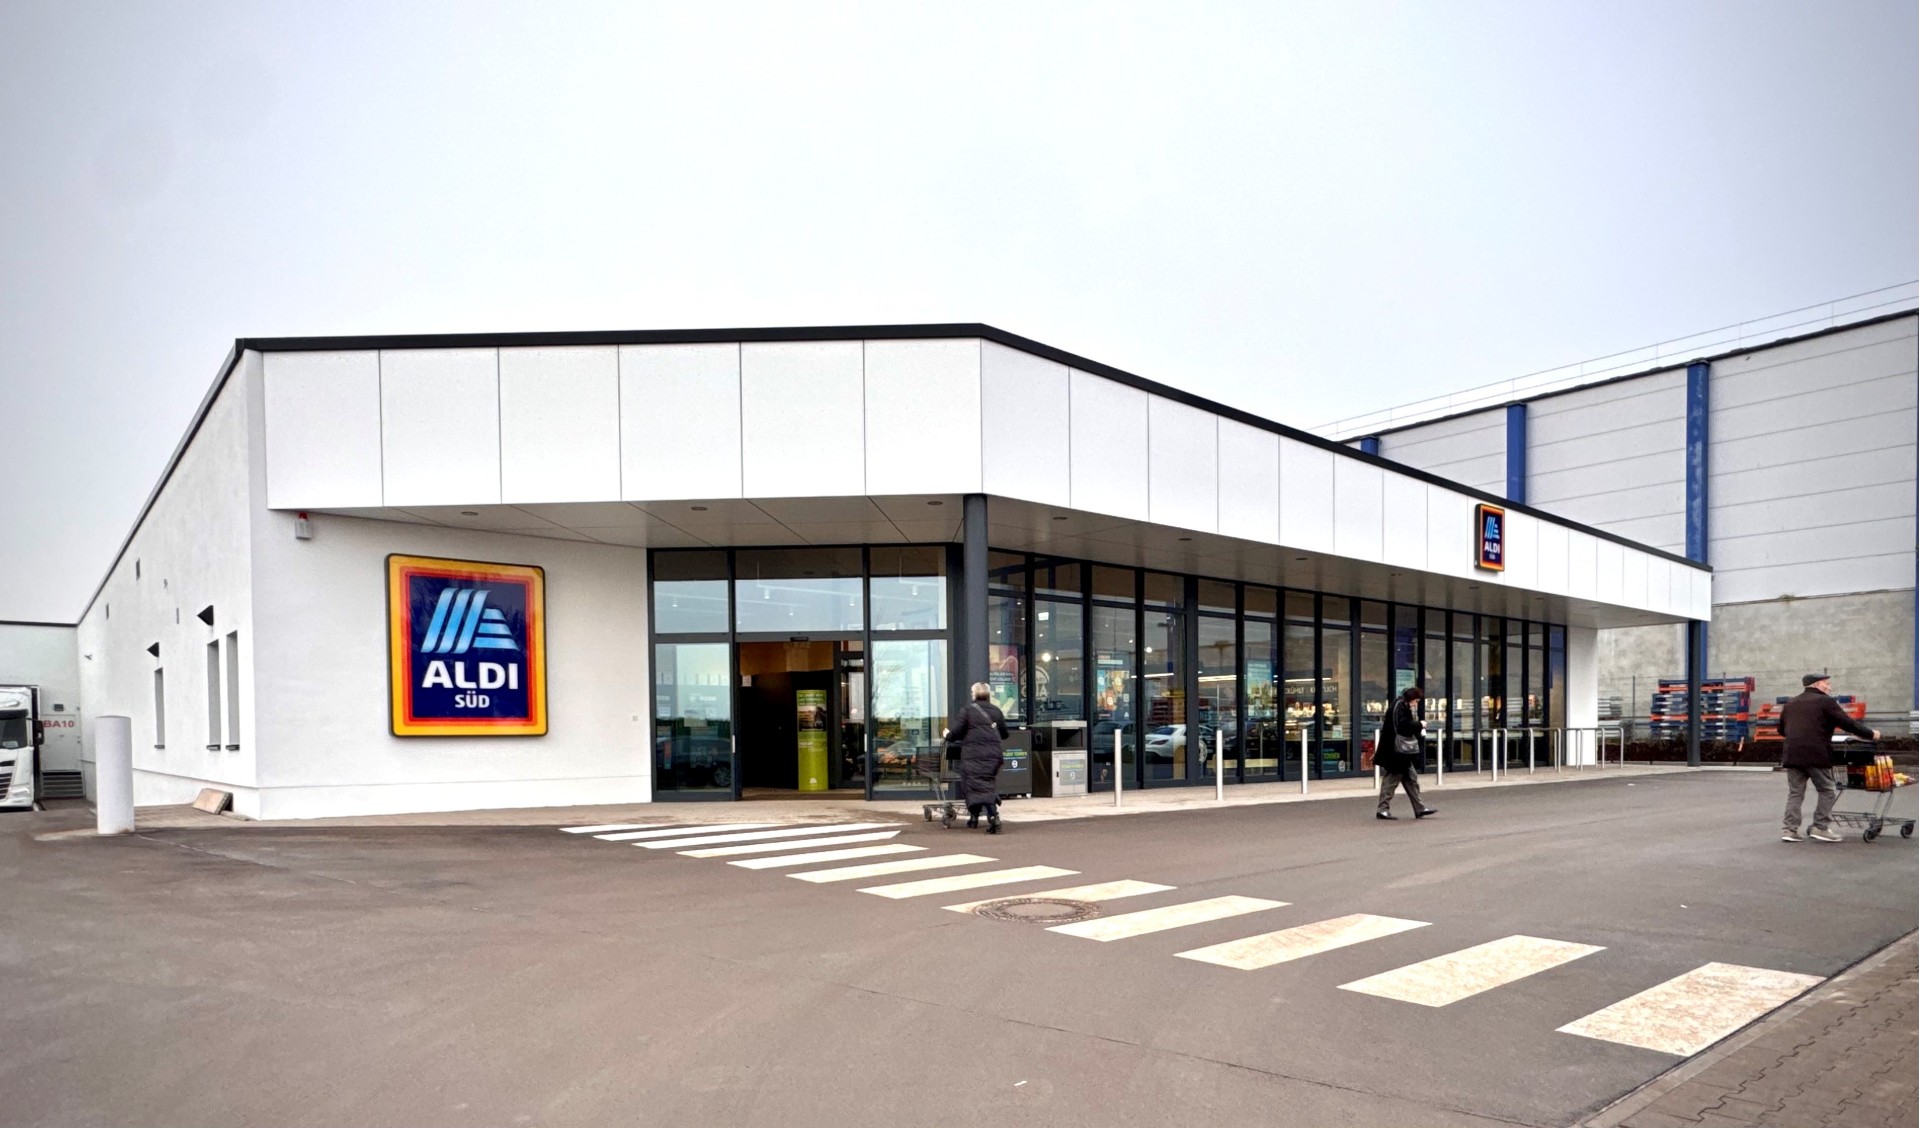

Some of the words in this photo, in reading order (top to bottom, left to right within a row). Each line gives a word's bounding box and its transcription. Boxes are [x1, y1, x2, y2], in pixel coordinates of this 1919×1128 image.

[1484, 541, 1500, 554] ALDI
[422, 660, 518, 689] ALDI
[454, 690, 490, 708] SÜD
